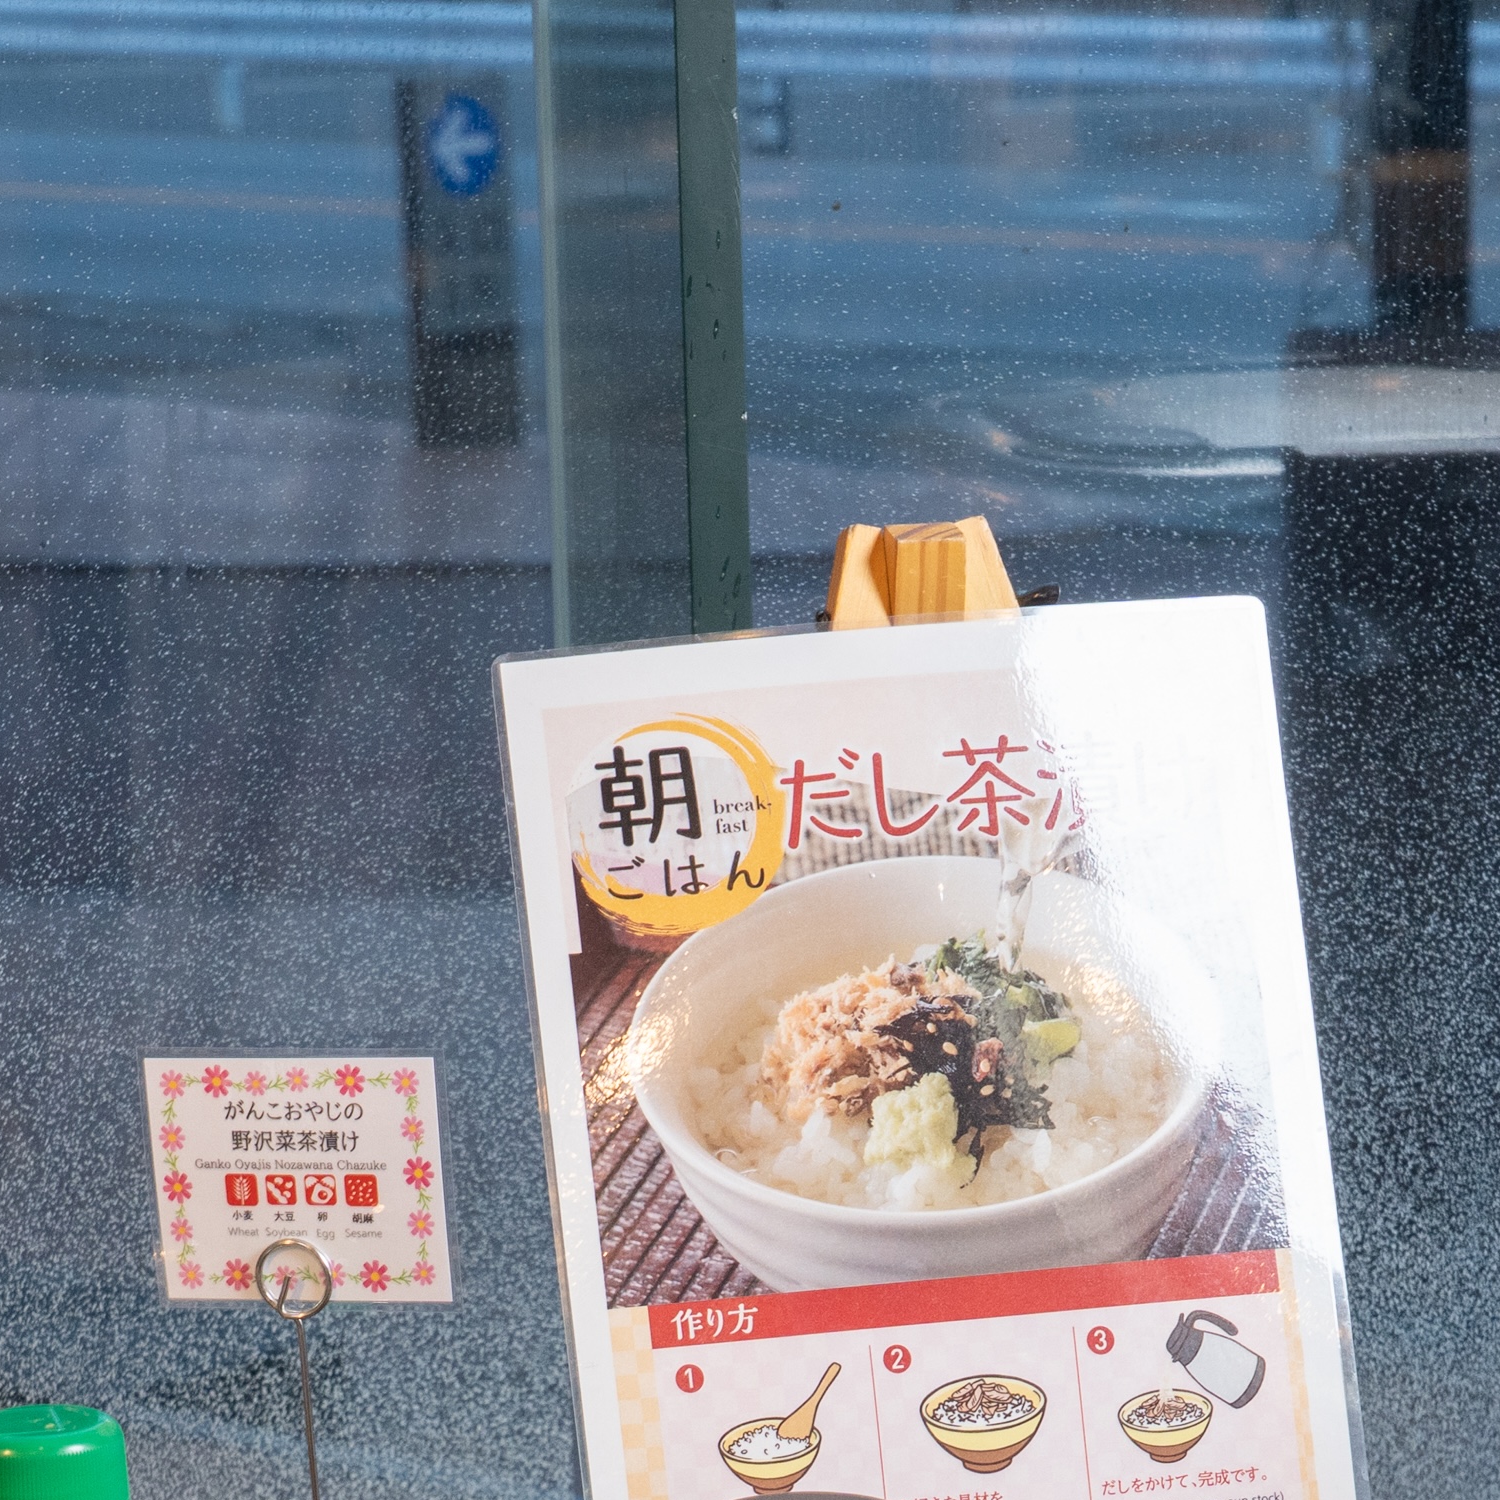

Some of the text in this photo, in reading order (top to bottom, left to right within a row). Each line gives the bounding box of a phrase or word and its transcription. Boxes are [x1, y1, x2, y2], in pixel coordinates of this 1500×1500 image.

[595, 746, 702, 847] 朝
[713, 795, 772, 815] break-
[715, 818, 749, 835] fast
[608, 850, 765, 900] ごはん
[224, 1100, 364, 1122] がんこおやじの
[231, 1130, 359, 1152] 野沢菜茶漬け
[194, 1159, 231, 1171] Ganko
[274, 1159, 334, 1171] Nozawana
[336, 1159, 388, 1172] Chazuke
[232, 1210, 254, 1222] 小麦
[274, 1211, 296, 1222] 大豆
[317, 1211, 328, 1222] 卵
[352, 1213, 375, 1224] 胡麻
[228, 1227, 259, 1238] Wheat
[265, 1227, 308, 1239] Soybean
[316, 1229, 335, 1241] Egg
[345, 1229, 383, 1239] Sesame
[671, 1303, 759, 1341] 作り方
[1102, 1466, 1268, 1496] だしをかけて、完成です。
